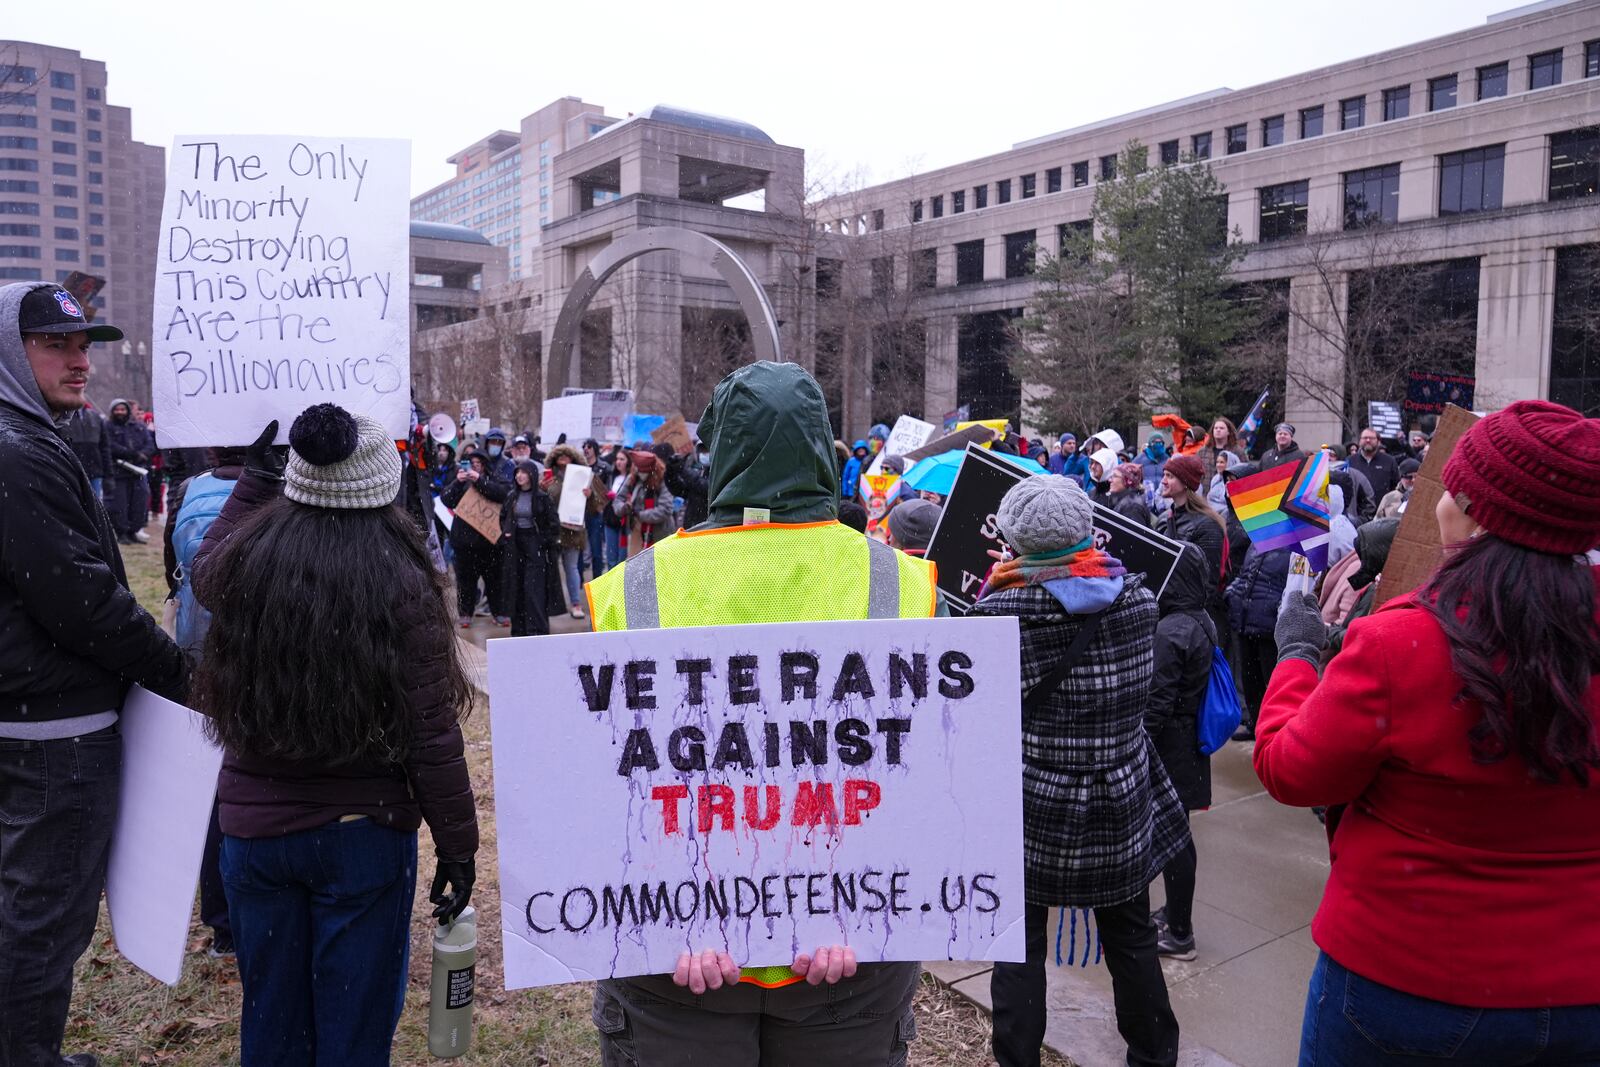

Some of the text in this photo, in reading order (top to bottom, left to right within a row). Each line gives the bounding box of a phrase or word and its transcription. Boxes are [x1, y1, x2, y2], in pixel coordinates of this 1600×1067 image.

[182, 142, 368, 202] The Only
[176, 185, 309, 243] Minority
[169, 226, 351, 284] Destroying
[163, 266, 391, 320] This Country
[165, 303, 336, 343] Are the
[170, 349, 401, 405] Billionaires
[577, 649, 975, 712] VETERANS
[617, 717, 911, 776] AGAINST
[650, 779, 881, 835] TRUMP
[525, 870, 1001, 934] COMMONDEFENSE.US
